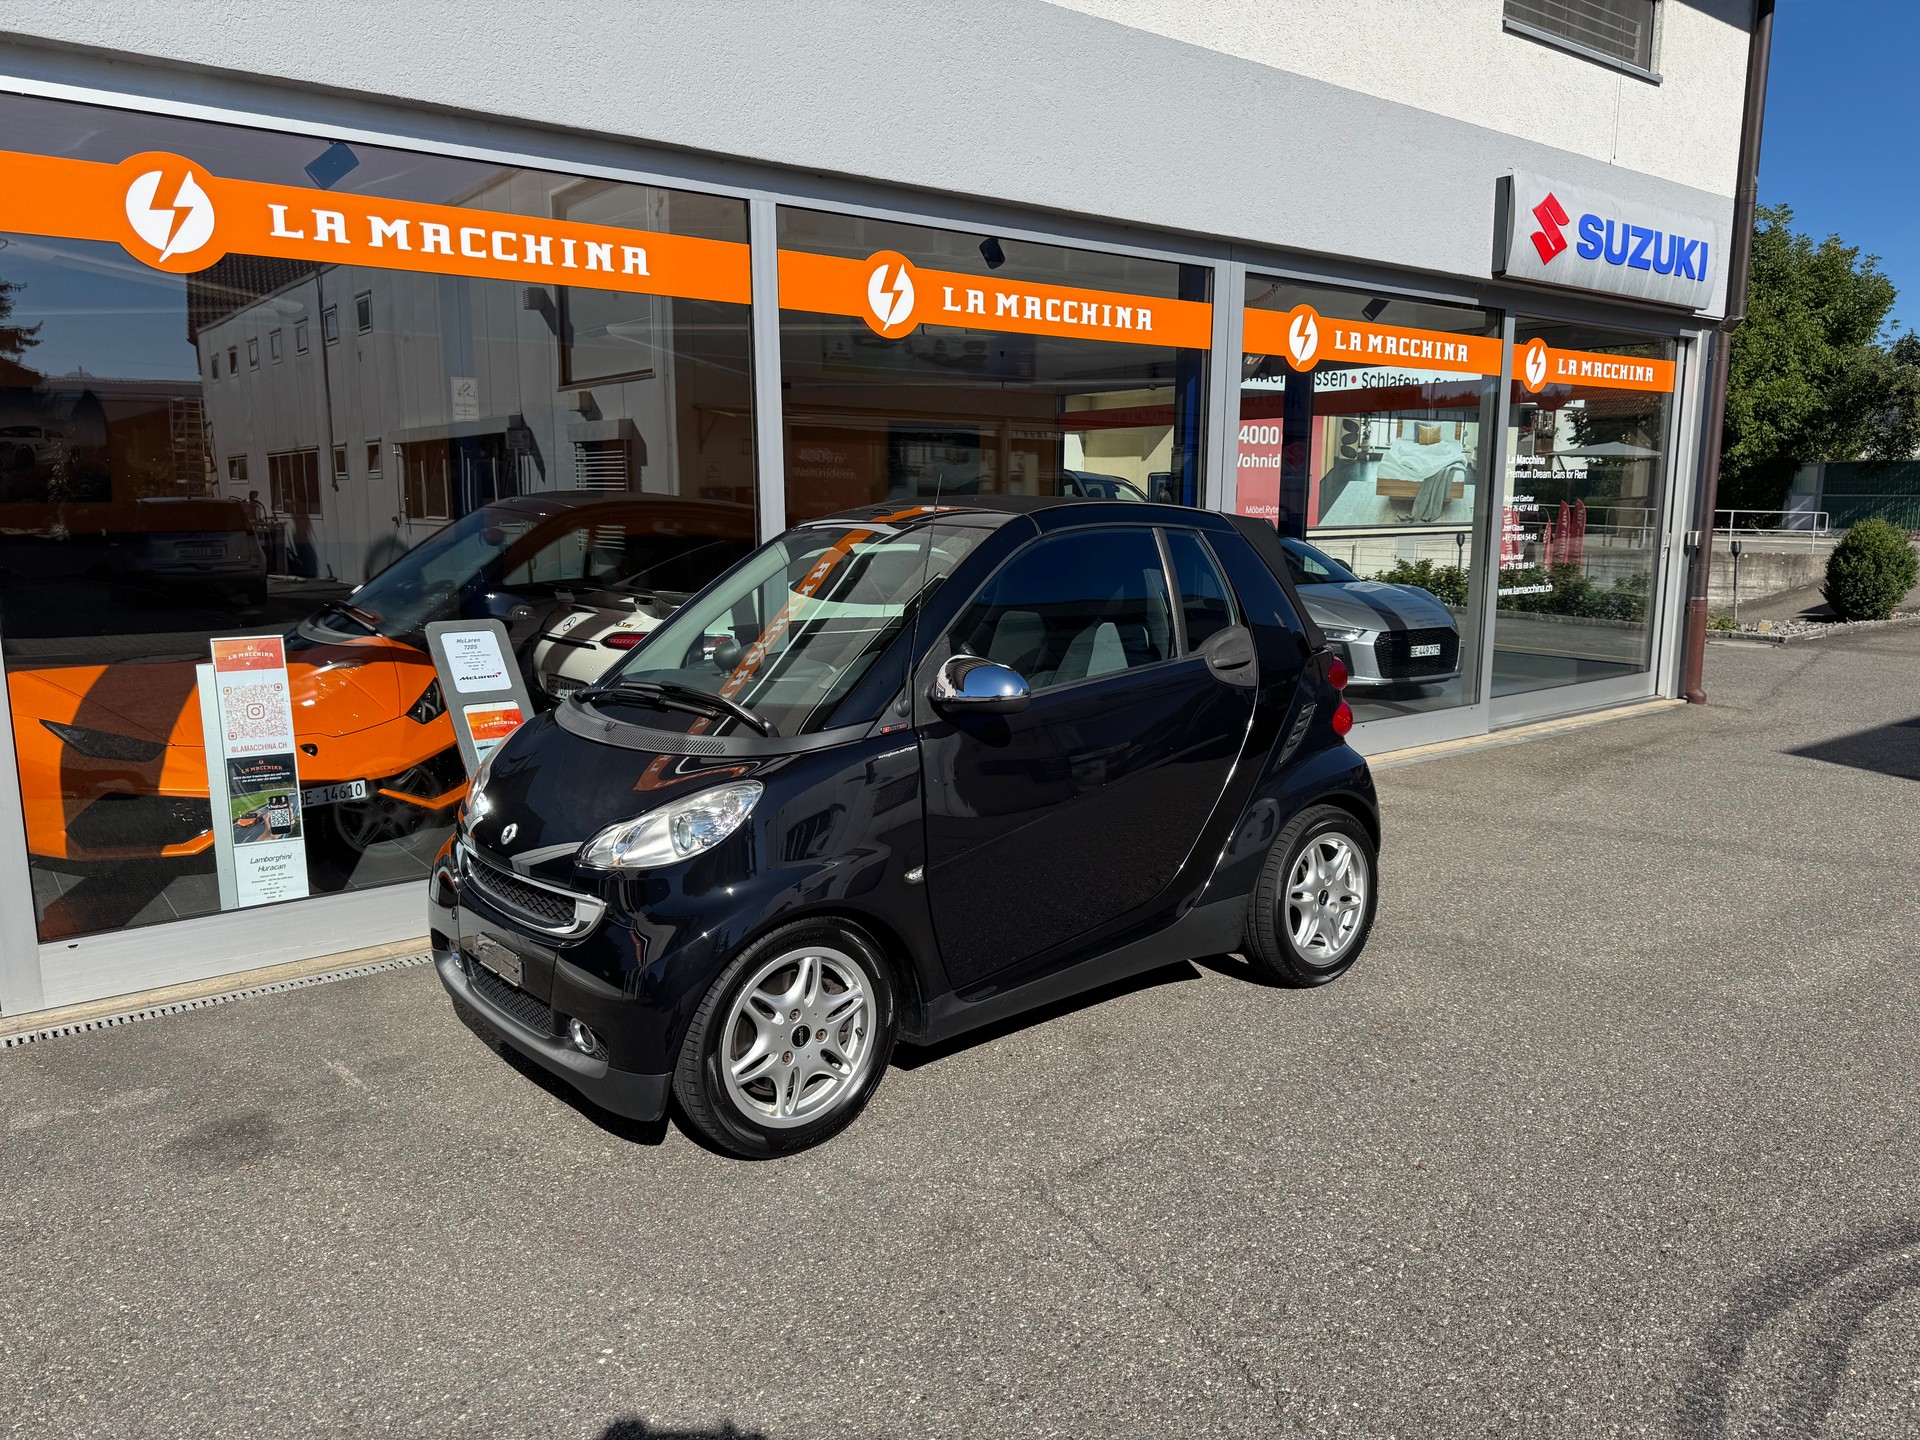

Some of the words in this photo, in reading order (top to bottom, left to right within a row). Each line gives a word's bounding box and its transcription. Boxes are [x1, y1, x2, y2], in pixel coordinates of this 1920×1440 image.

[267, 203, 351, 244] LA
[366, 215, 651, 276] MACCHINA
[1576, 213, 1709, 282] SUZUKI
[942, 286, 986, 315] LA
[995, 292, 1154, 331] MACCHINA
[1334, 330, 1362, 352] LA
[1366, 333, 1469, 363] MACCHINA
[1557, 358, 1577, 376] LA
[1580, 360, 1655, 382] MACCHINA
[1361, 371, 1420, 388] Schlafen
[1238, 425, 1280, 445] 4000
[1507, 454, 1516, 465] La
[1516, 453, 1546, 465] Macchina
[1506, 468, 1532, 479] Premium
[1532, 469, 1552, 479] Dream
[1552, 469, 1566, 479] Cars
[1566, 469, 1574, 479] for
[1574, 469, 1588, 479] Rent
[1497, 582, 1554, 596] www.lamacchina.ch
[459, 673, 499, 681] McLaren
[231, 742, 288, 753] @LAMACCHINA.CH
[323, 782, 363, 802] 14610
[249, 852, 293, 865] Lamborghini
[257, 863, 287, 873] Huracan
